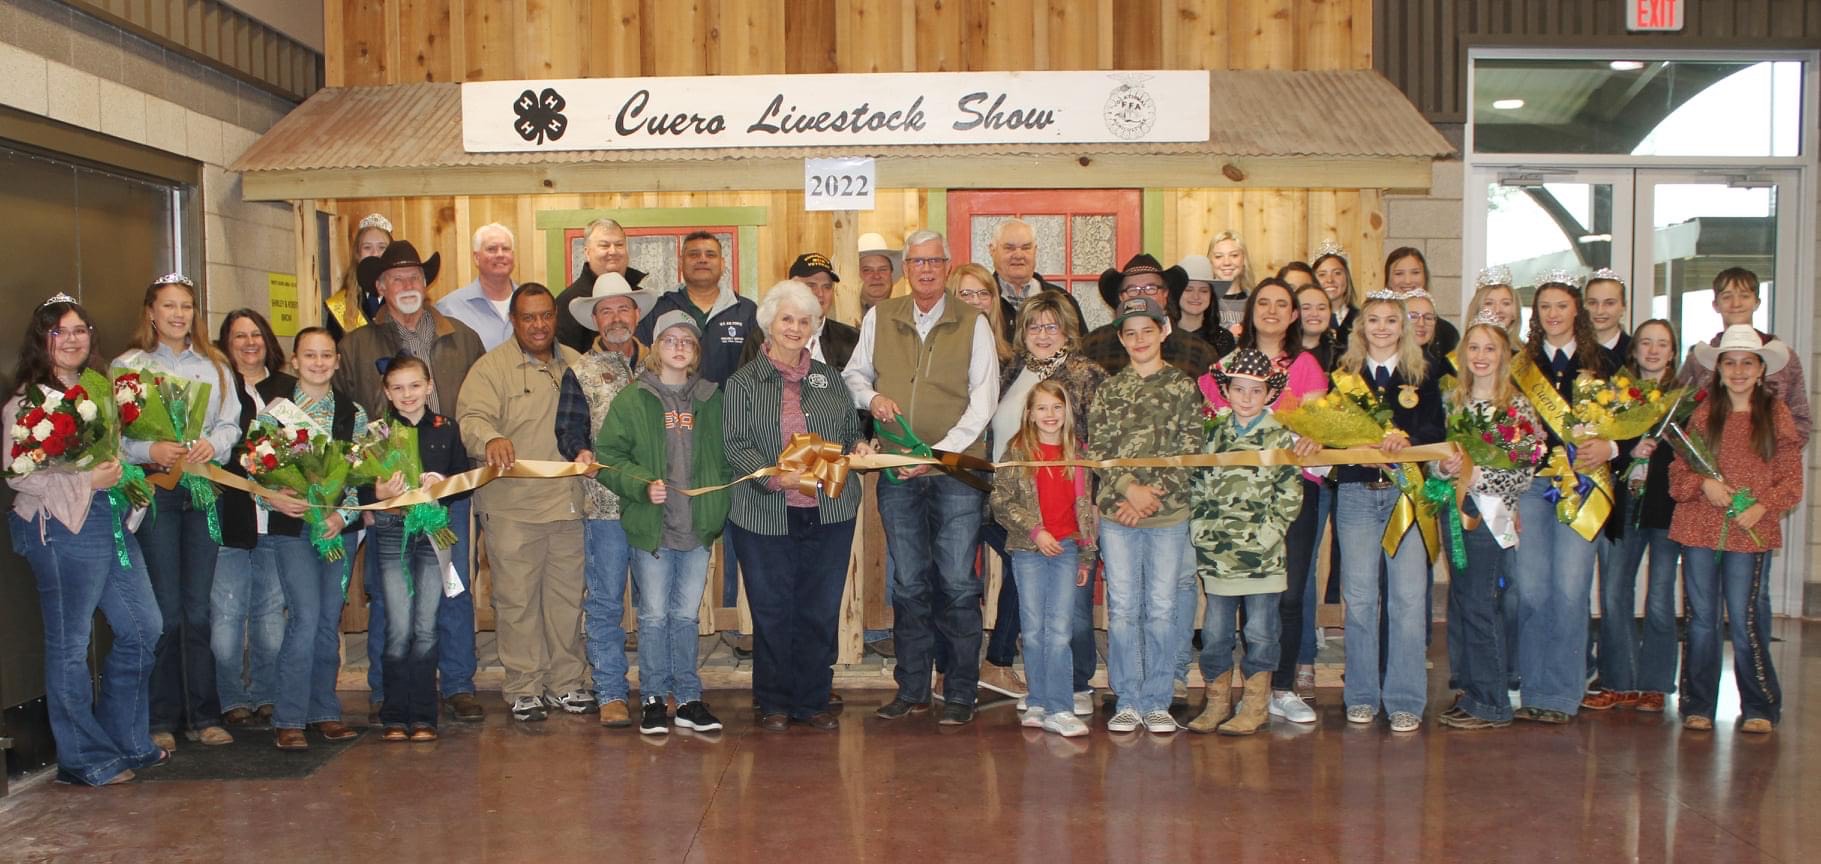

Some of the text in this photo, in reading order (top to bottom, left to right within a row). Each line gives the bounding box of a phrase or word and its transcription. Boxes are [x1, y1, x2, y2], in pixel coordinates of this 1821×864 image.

[1636, 0, 1676, 28] EXIT
[520, 96, 533, 110] H
[544, 95, 558, 109] H
[1121, 101, 1142, 111] FFA
[615, 89, 1054, 136] Cuero Livestock Show
[521, 121, 534, 134] H
[548, 119, 561, 132] H
[810, 175, 869, 197] 2022
[1532, 383, 1557, 412] Cuero
